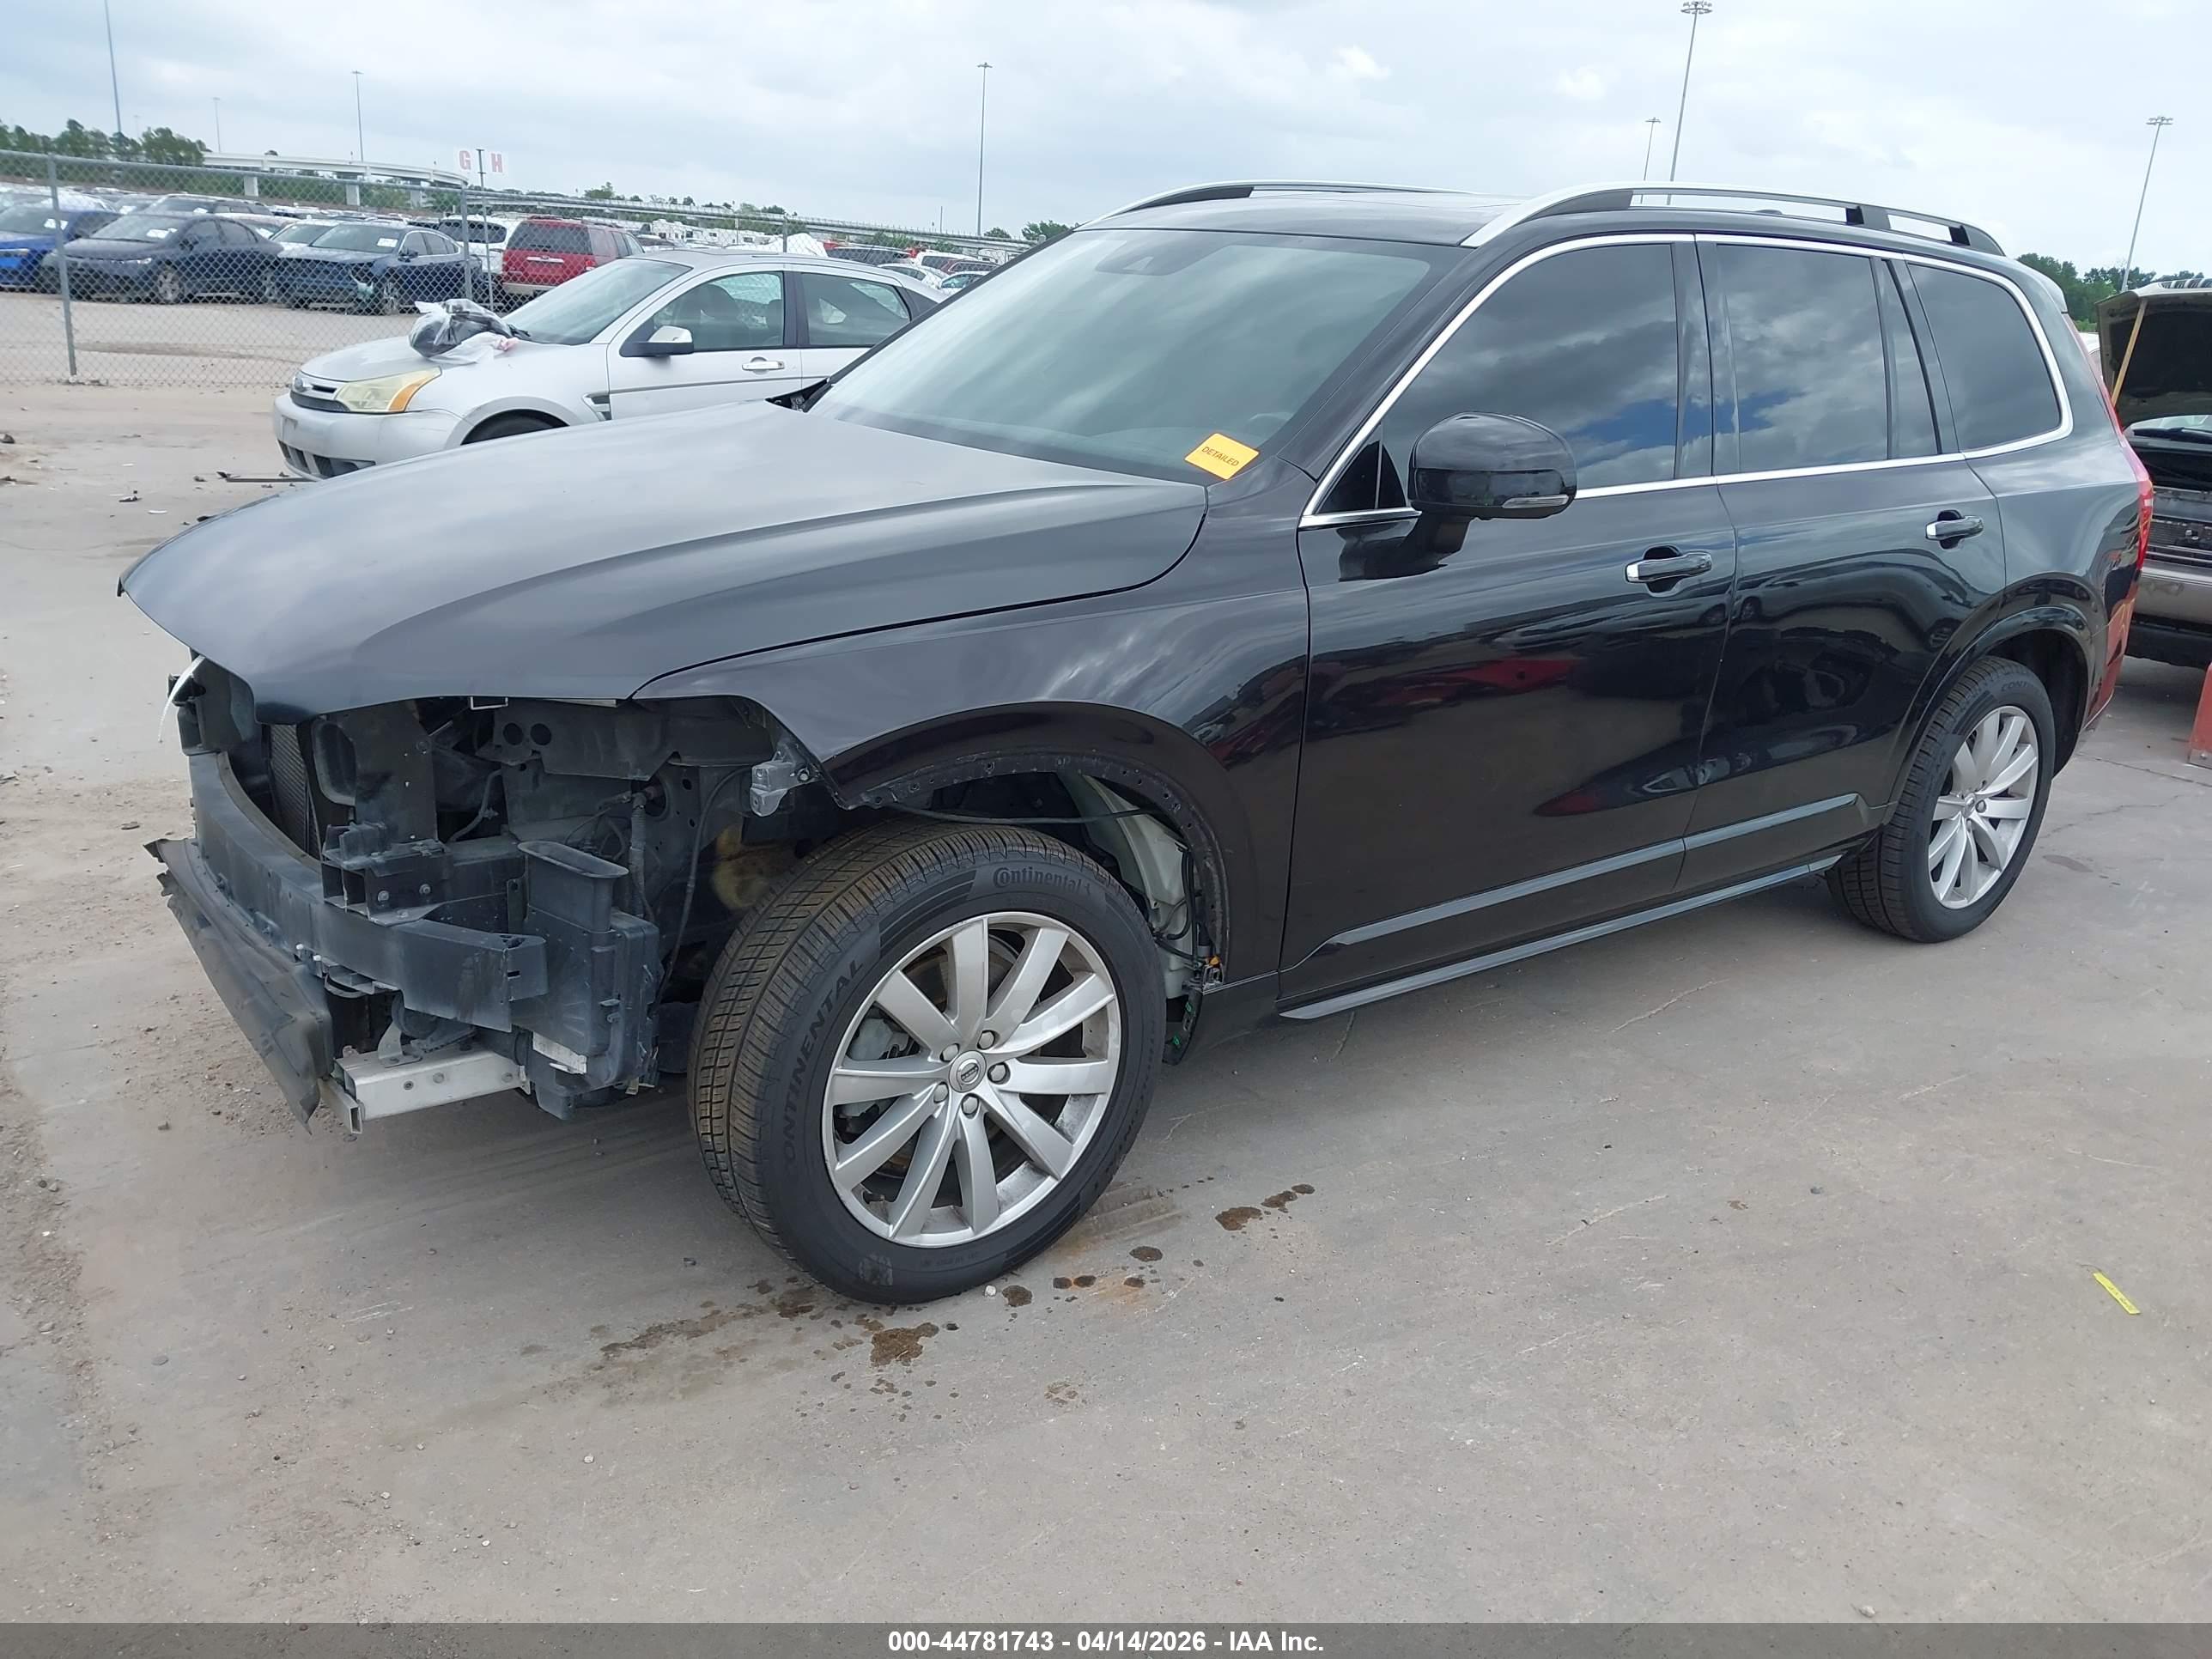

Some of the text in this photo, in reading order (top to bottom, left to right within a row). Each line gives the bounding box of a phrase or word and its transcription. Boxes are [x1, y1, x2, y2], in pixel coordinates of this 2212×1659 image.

[459, 150, 471, 170] G
[490, 153, 503, 173] H
[1201, 446, 1240, 466] DETAILED
[993, 866, 1082, 894] Continental
